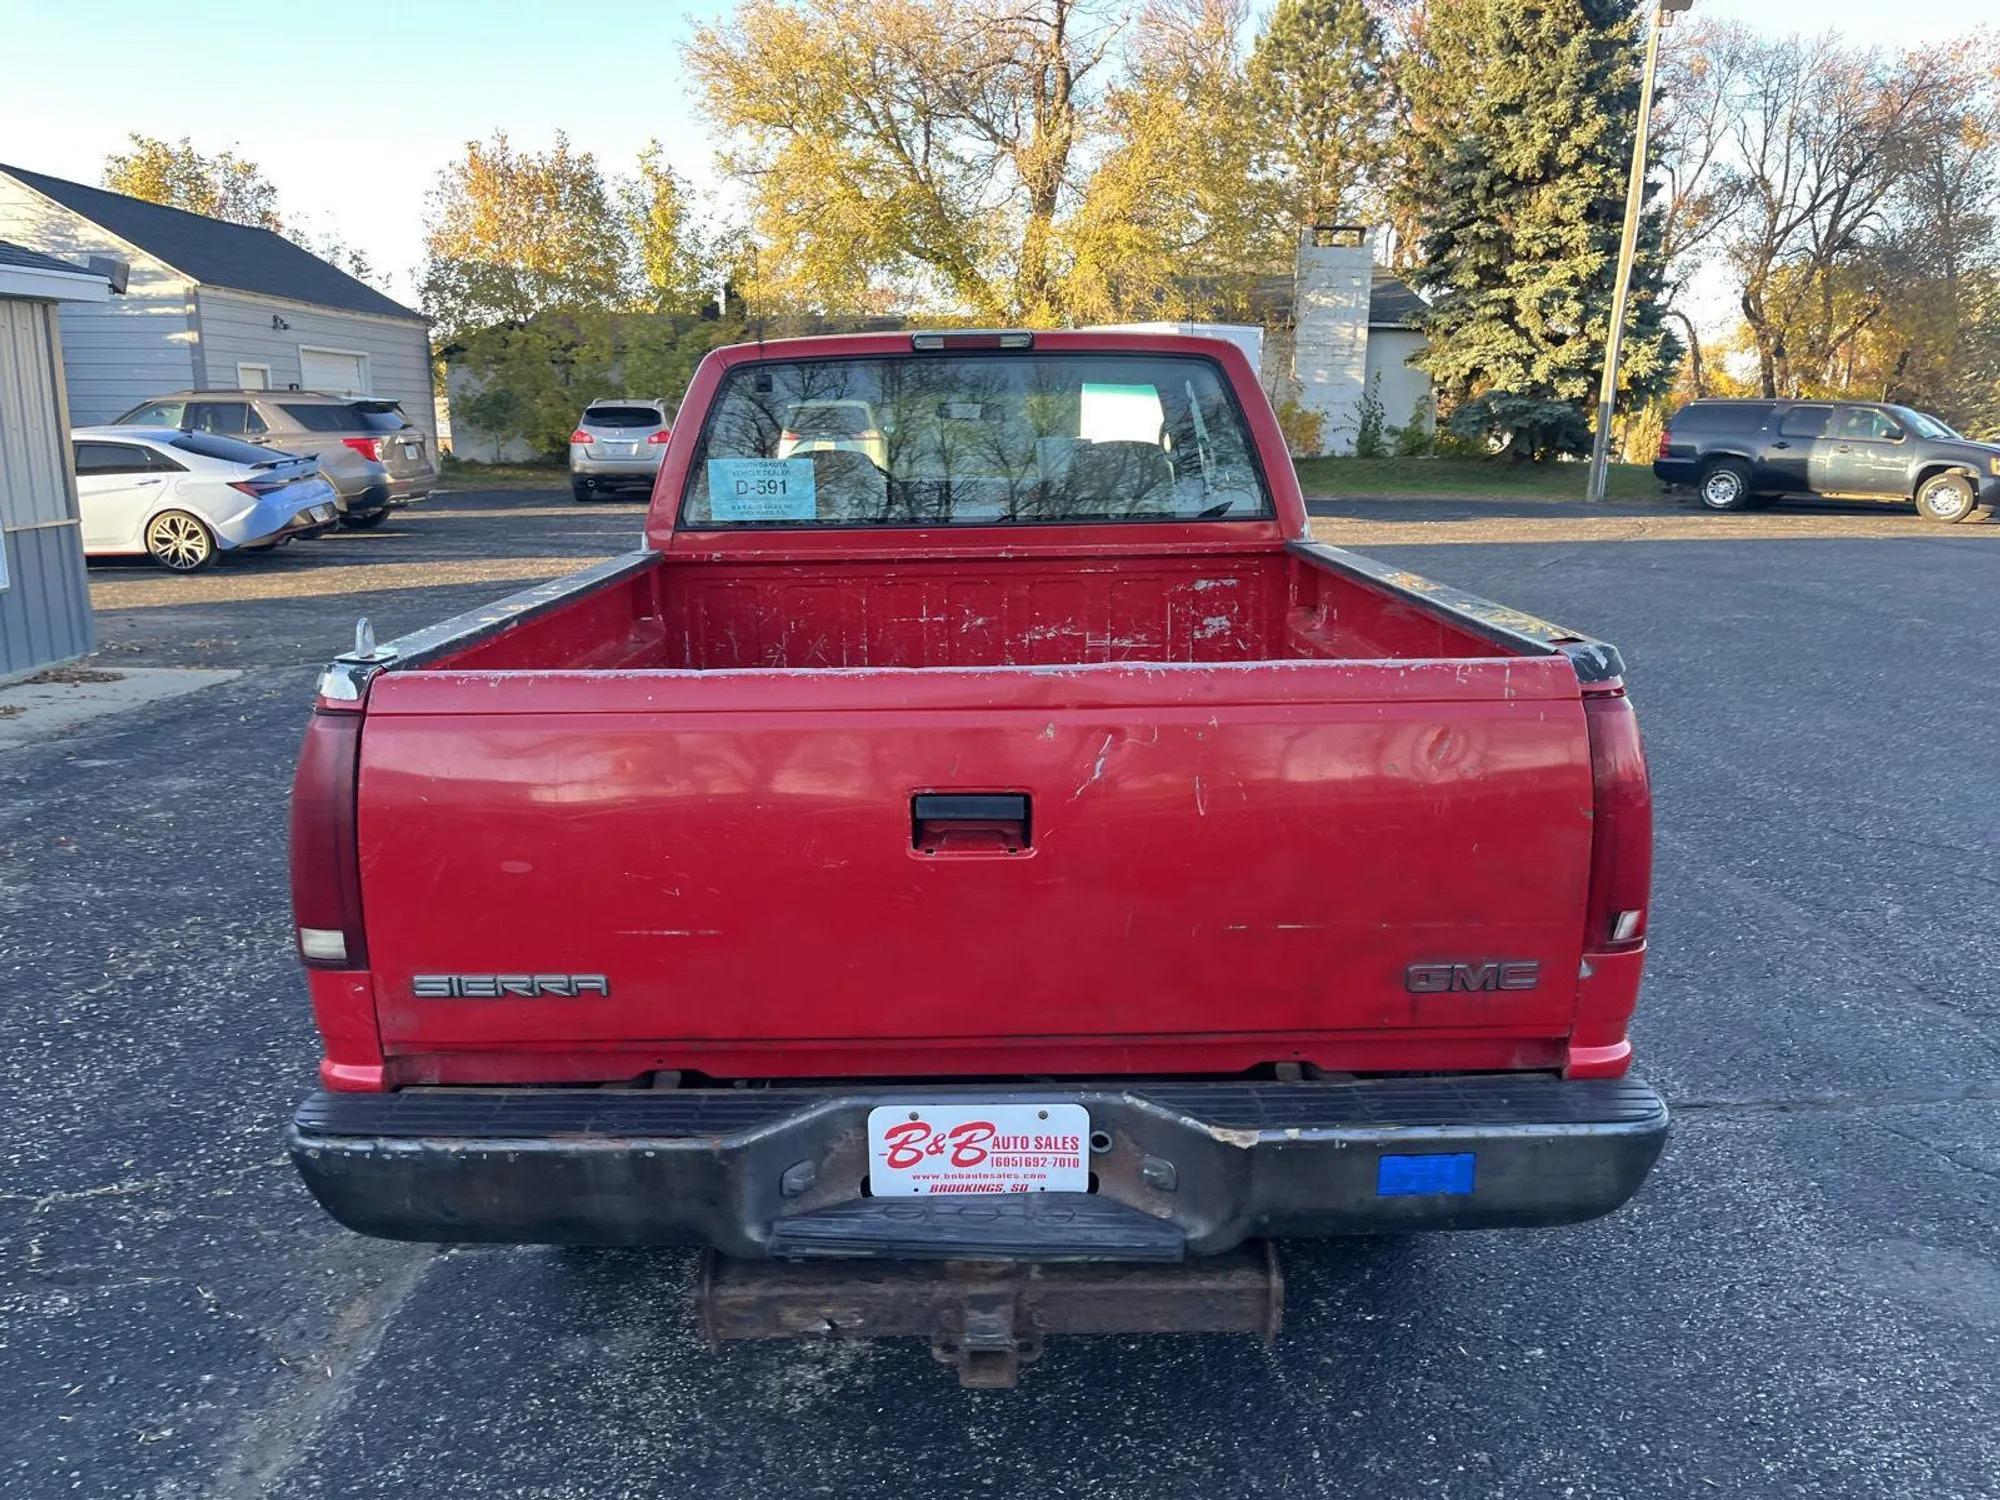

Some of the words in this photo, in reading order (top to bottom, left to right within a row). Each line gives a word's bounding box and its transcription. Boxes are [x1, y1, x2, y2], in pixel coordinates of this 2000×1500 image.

[736, 479, 787, 495] D-591
[413, 974, 608, 998] SIERRA
[1406, 960, 1539, 993] GMC
[884, 1121, 996, 1169] B&B
[992, 1136, 1029, 1150] AUTO
[1034, 1136, 1079, 1150] SALES
[929, 1183, 1006, 1193] BROOKINGS,
[1010, 1183, 1029, 1192] SD
